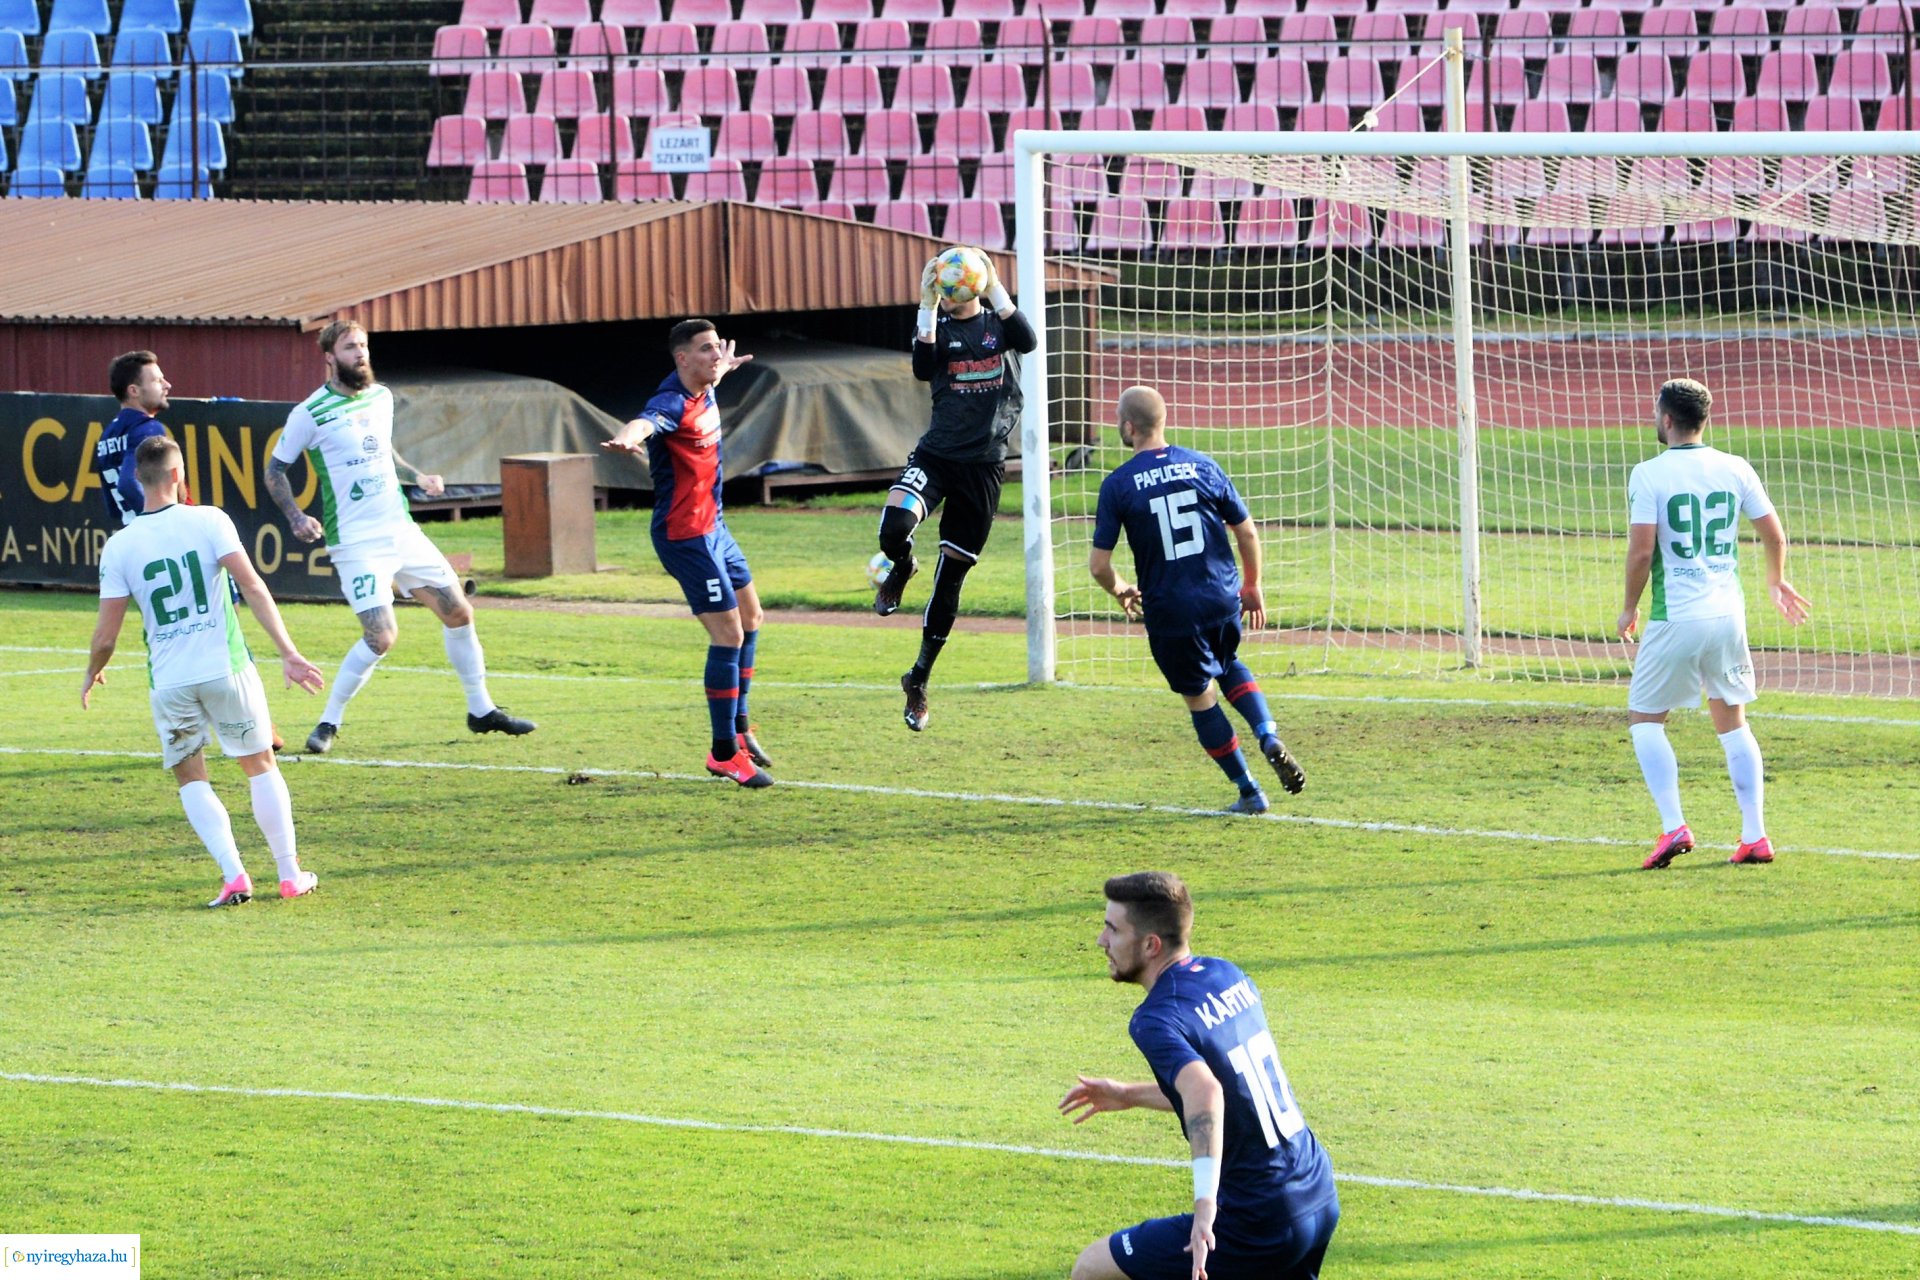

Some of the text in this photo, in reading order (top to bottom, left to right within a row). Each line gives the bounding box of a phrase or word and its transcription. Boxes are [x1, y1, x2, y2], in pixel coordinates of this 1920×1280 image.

[656, 153, 705, 164] SZEKTOR
[22, 417, 318, 511] CAINO
[1133, 463, 1199, 491] PAPUCSEK
[1149, 489, 1206, 561] 15
[1667, 491, 1736, 559] 92
[143, 550, 209, 626] 21
[352, 575, 376, 600] 27
[706, 578, 723, 603] 5
[1227, 1030, 1305, 1149] 10
